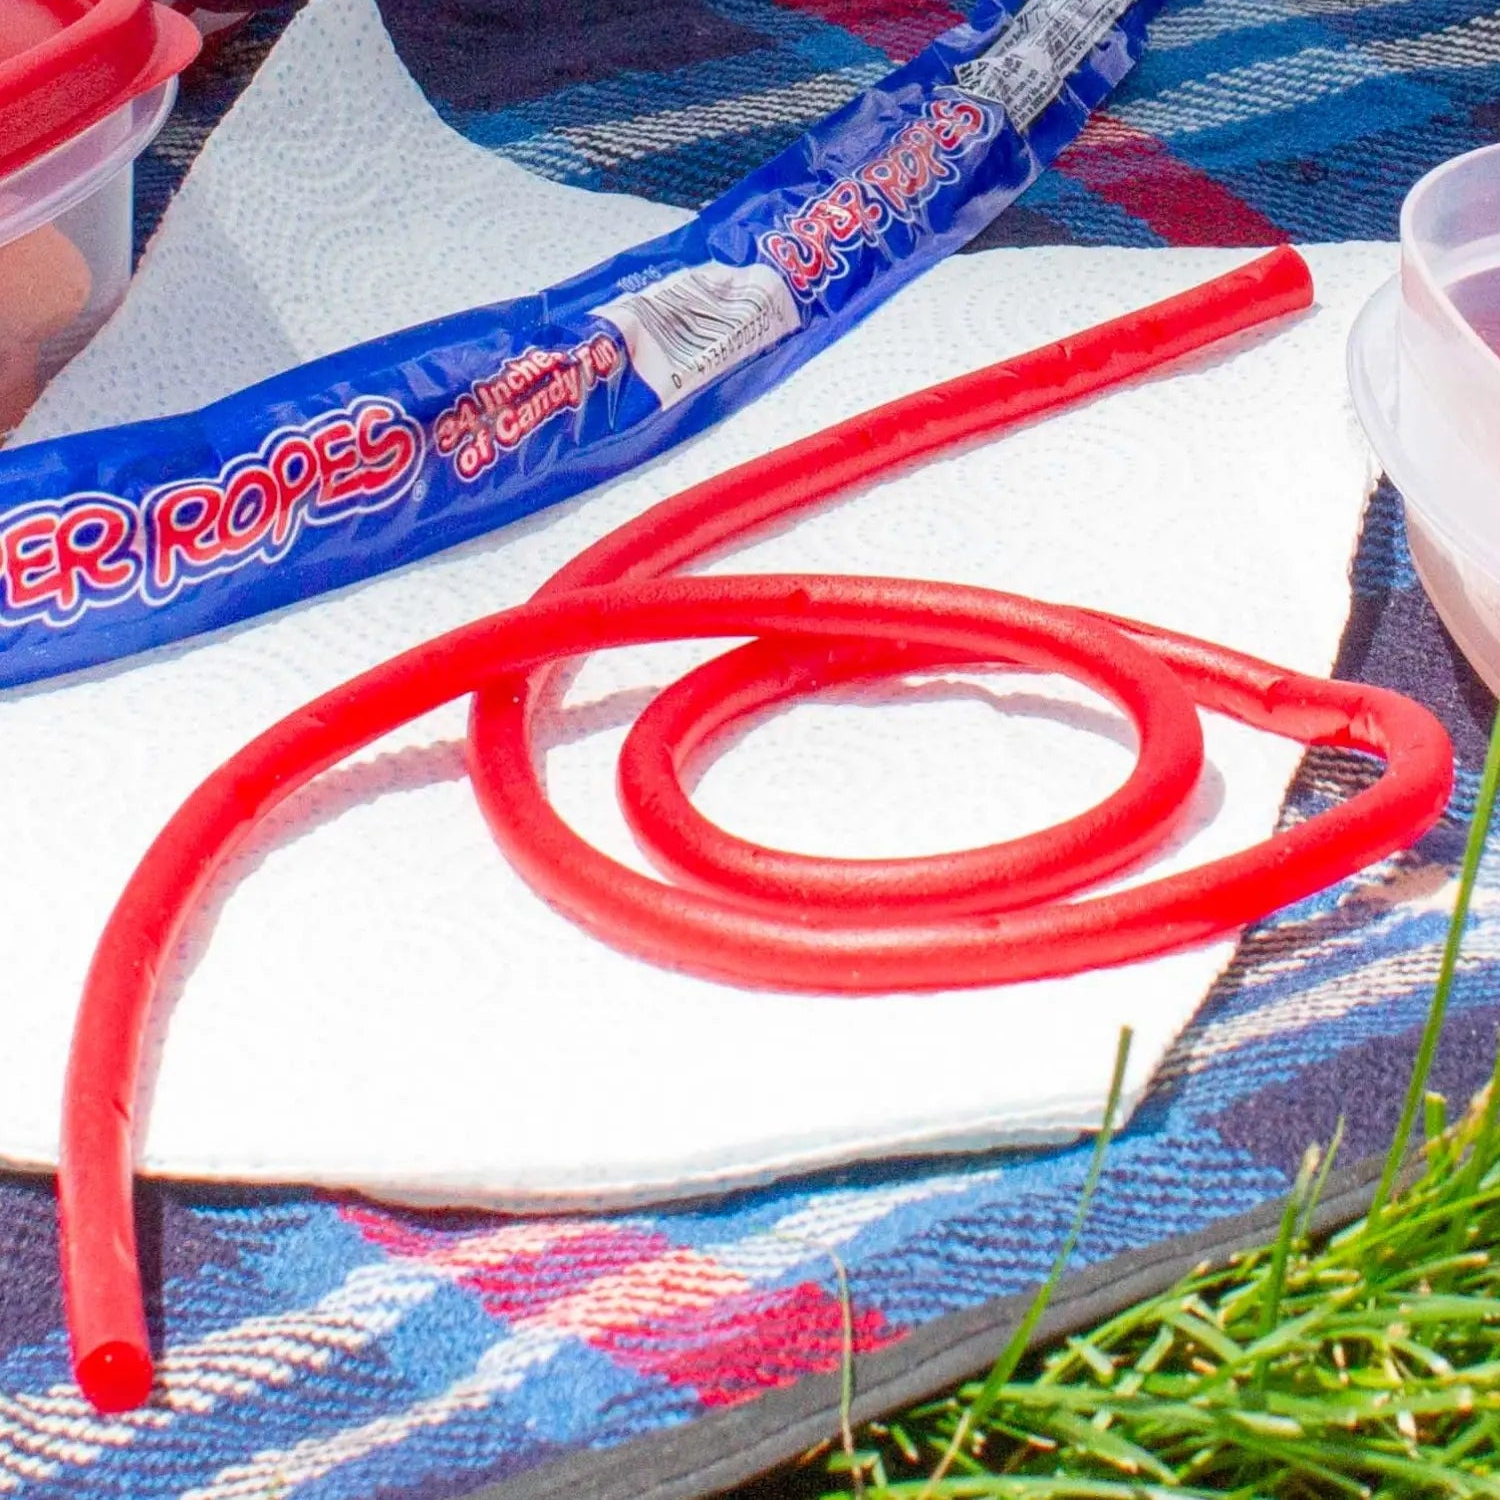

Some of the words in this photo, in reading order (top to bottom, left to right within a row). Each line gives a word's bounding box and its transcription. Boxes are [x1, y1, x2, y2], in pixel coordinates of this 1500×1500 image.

[764, 178, 888, 297] SUPER
[858, 99, 988, 216] ROPES
[456, 434, 494, 478] of
[494, 364, 582, 446] Candy
[578, 334, 620, 391] Fun
[671, 373, 683, 390] 0
[146, 402, 418, 590] ROPES
